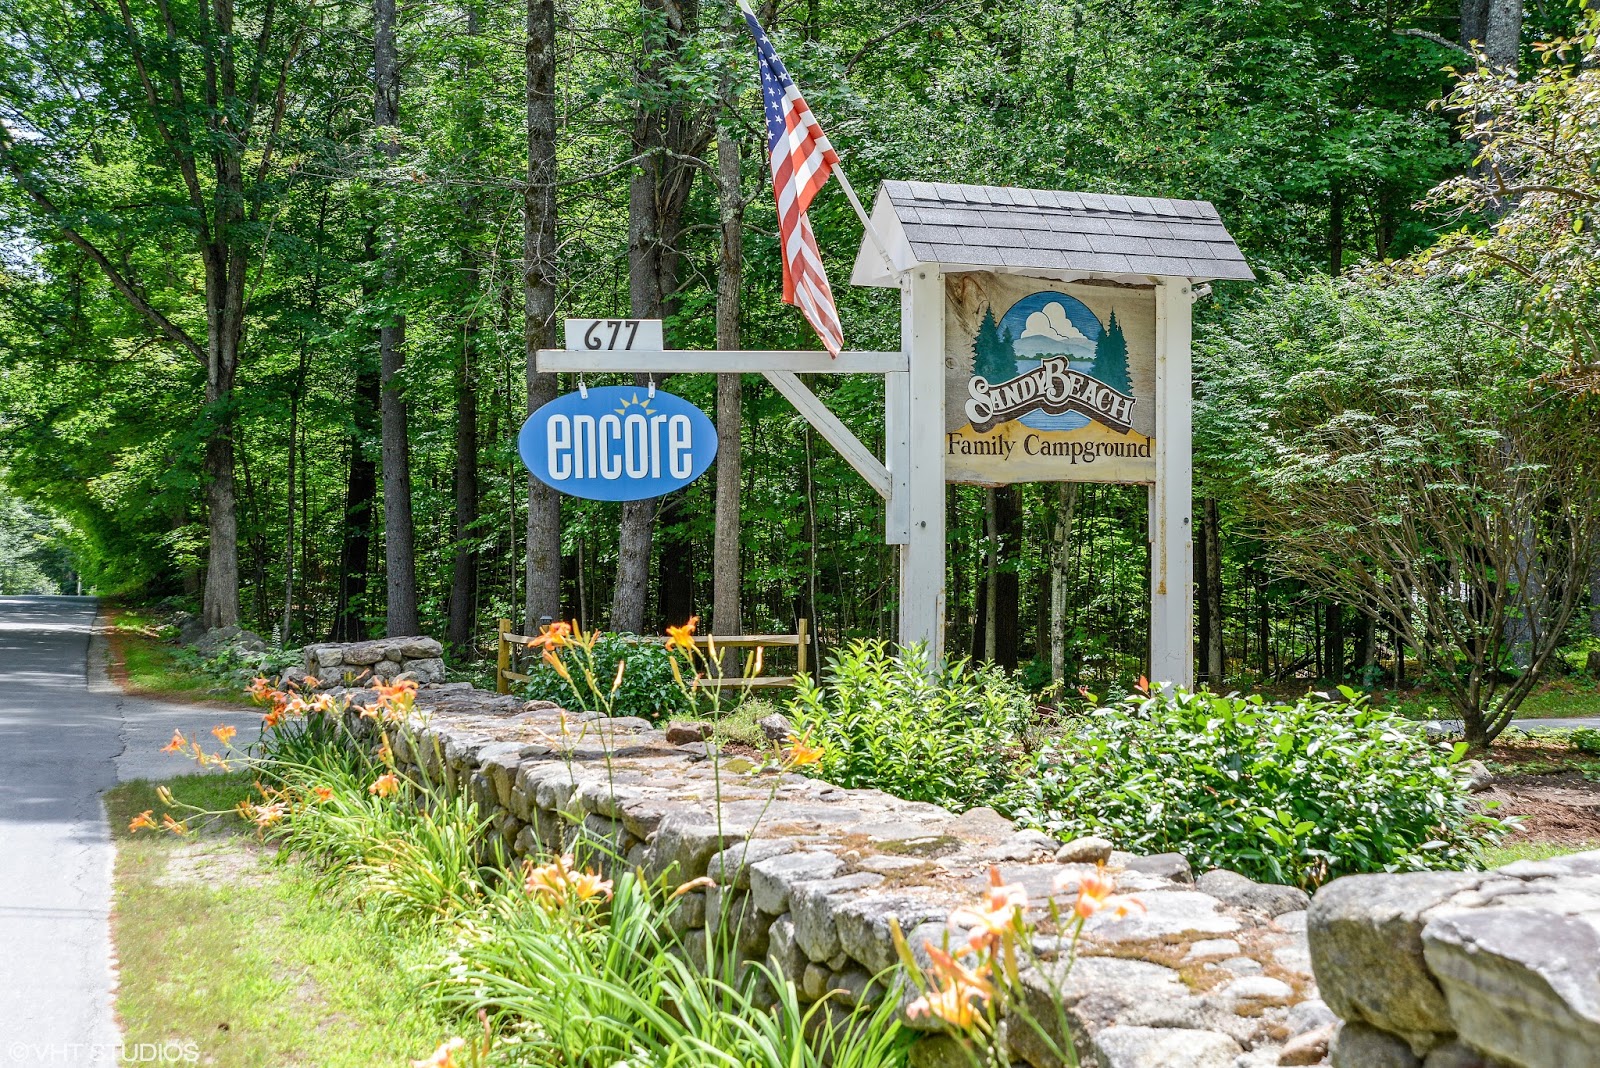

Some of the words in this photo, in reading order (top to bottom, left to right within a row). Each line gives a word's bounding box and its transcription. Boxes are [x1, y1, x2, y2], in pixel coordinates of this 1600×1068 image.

[584, 320, 640, 350] 677
[965, 370, 1047, 424] SANDY
[1043, 357, 1137, 426] BEACH
[547, 413, 693, 480] encore
[948, 432, 1016, 461] Family
[1023, 434, 1151, 465] Campground
